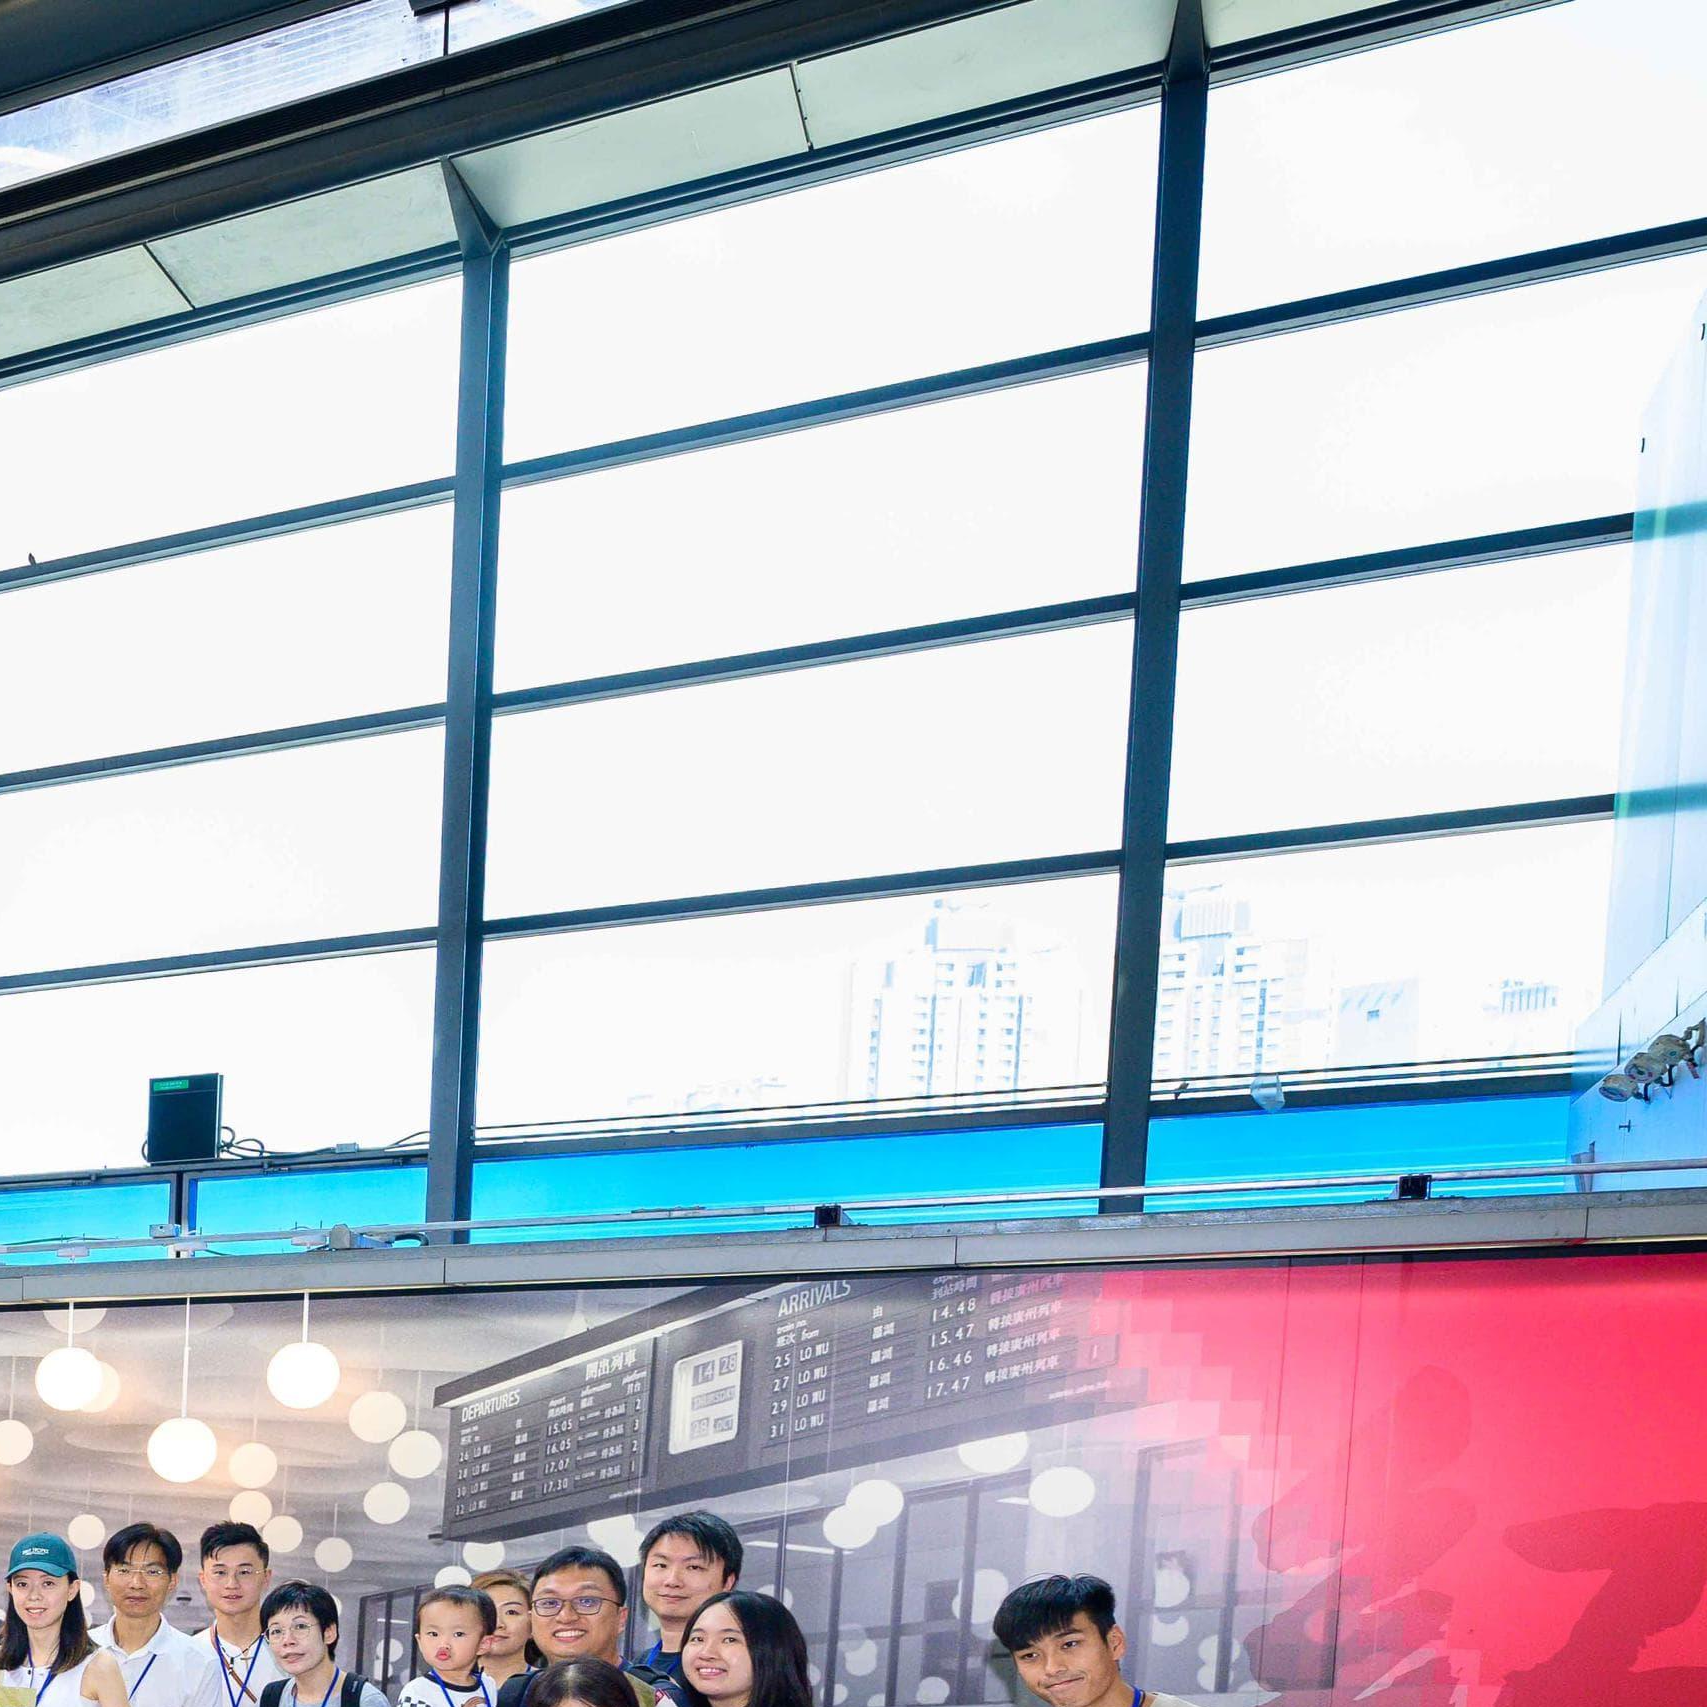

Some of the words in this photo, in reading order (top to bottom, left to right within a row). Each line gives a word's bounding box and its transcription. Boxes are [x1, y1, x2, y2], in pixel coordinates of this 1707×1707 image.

[778, 1280, 851, 1317] ARRIVALS
[775, 1354, 791, 1368] 25
[773, 1376, 790, 1392] 27
[462, 1389, 521, 1423] DEPARTURES
[771, 1400, 788, 1415] 29
